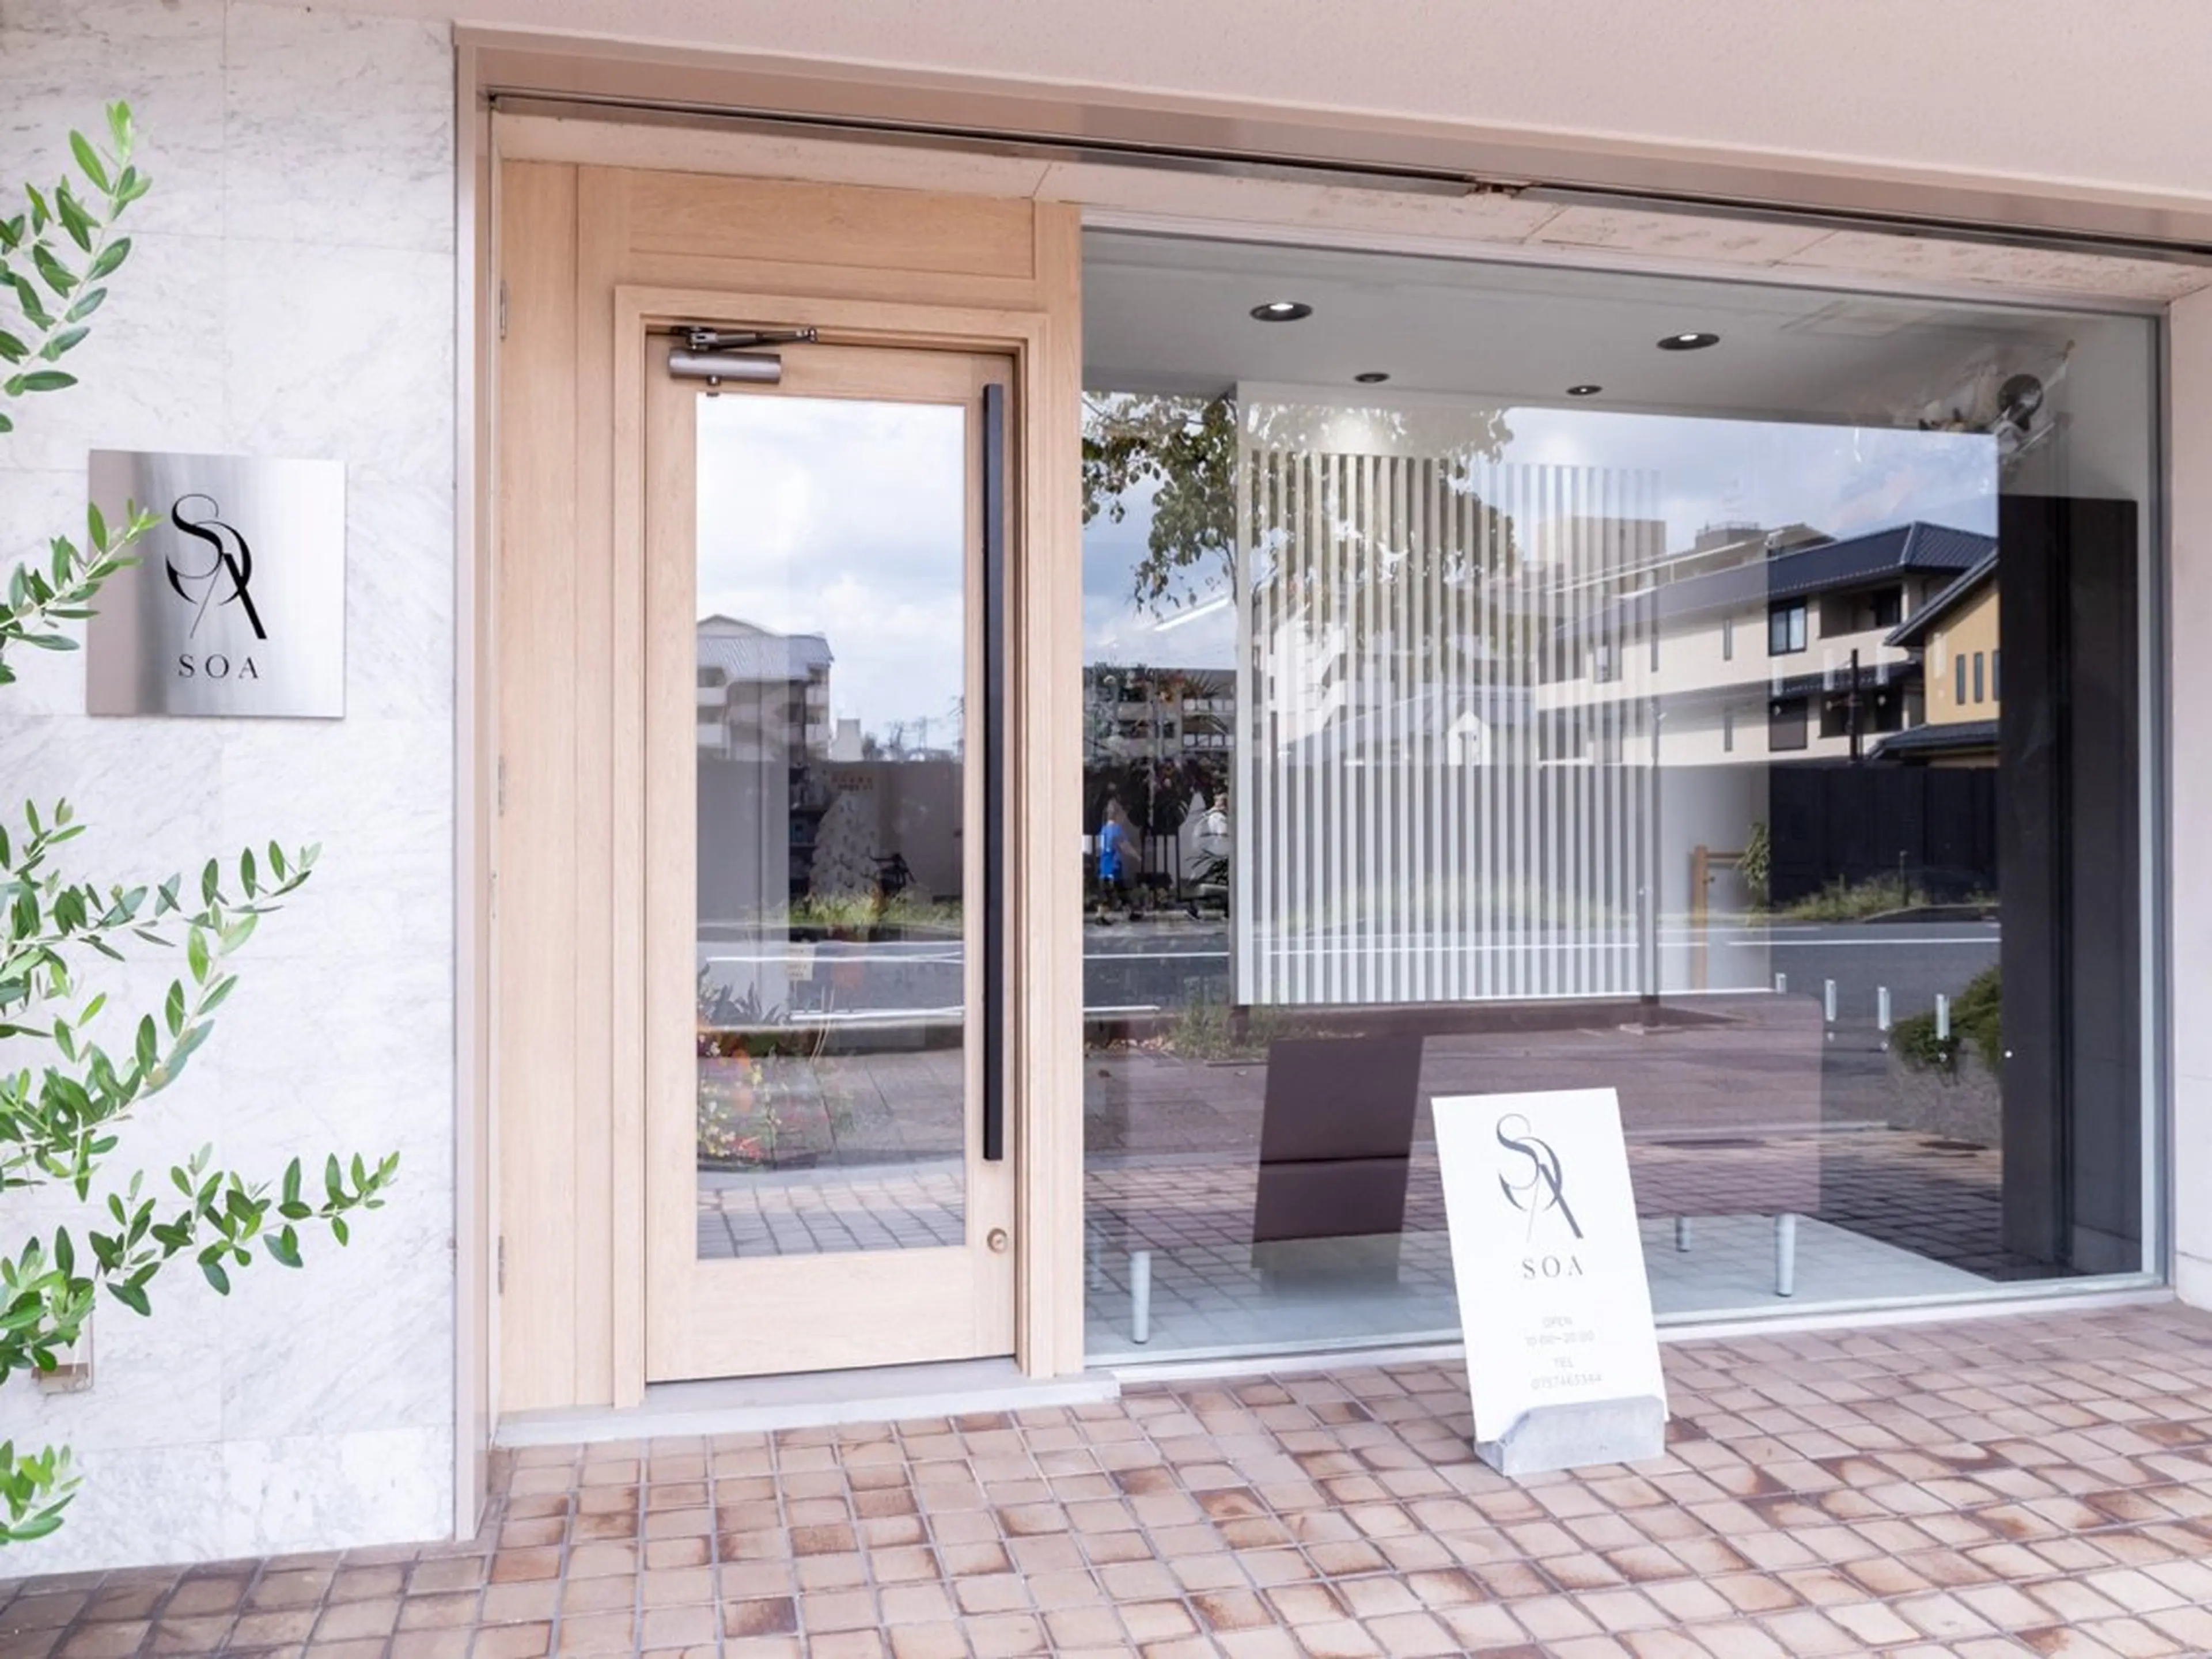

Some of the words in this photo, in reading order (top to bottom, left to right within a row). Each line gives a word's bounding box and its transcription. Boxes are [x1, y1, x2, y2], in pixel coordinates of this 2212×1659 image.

[177, 653, 259, 680] SOA
[1522, 1255, 1584, 1281] SOA
[1552, 1357, 1574, 1368] TEL
